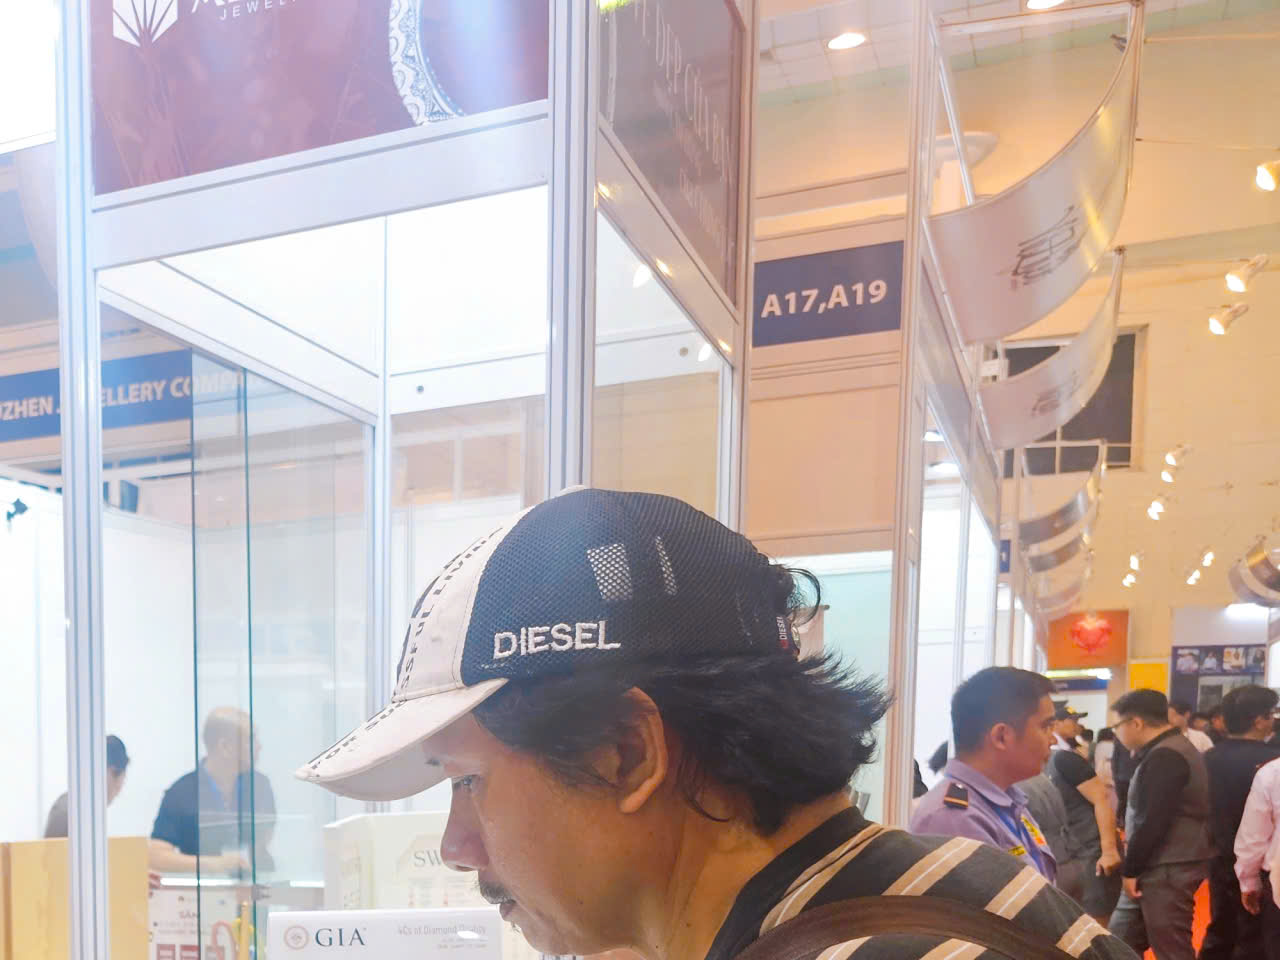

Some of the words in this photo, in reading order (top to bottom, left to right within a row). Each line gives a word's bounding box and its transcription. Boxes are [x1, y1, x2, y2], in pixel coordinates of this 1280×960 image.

[219, 0, 297, 21] JEWEL
[760, 279, 888, 319] A17,A19
[493, 619, 621, 660] DIESEL
[776, 616, 788, 640] DIESEL
[314, 927, 366, 947] GIA
